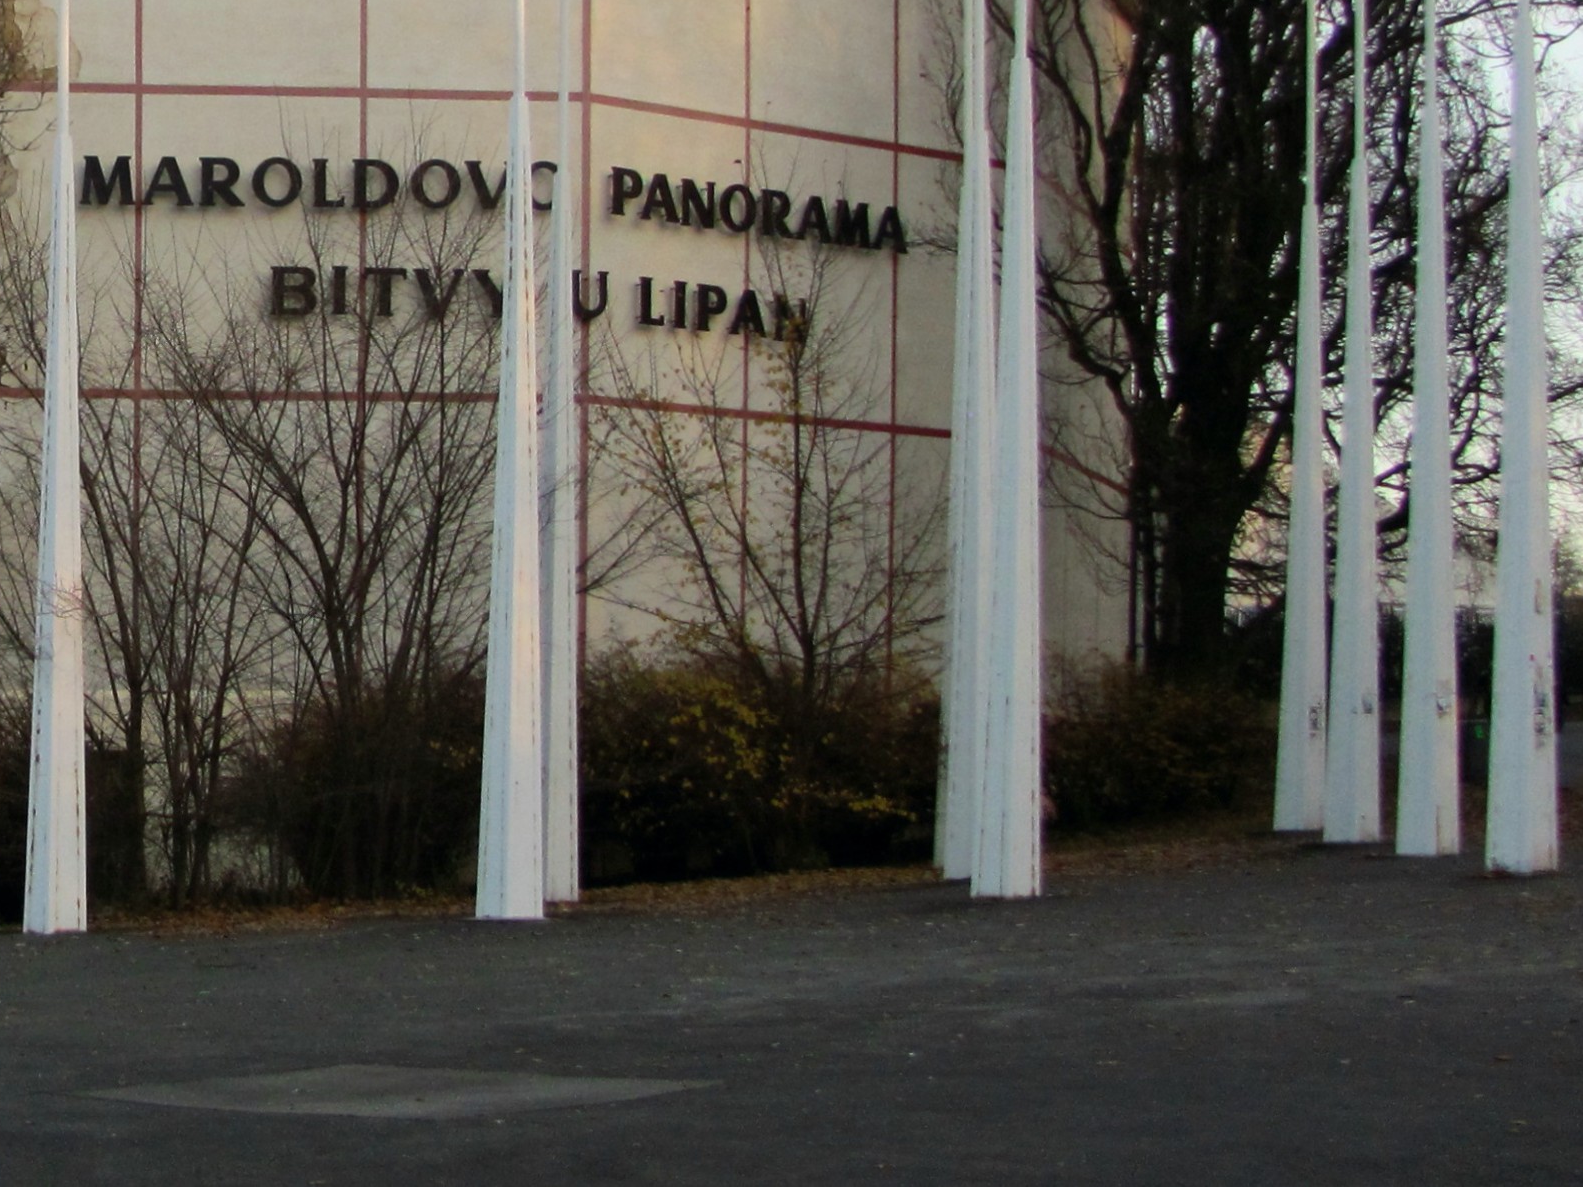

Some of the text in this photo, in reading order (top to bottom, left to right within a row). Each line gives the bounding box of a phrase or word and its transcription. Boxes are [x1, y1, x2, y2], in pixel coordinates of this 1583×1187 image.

[610, 165, 908, 254] PANORAMA
[270, 264, 808, 342] BITVY U LIPAN
